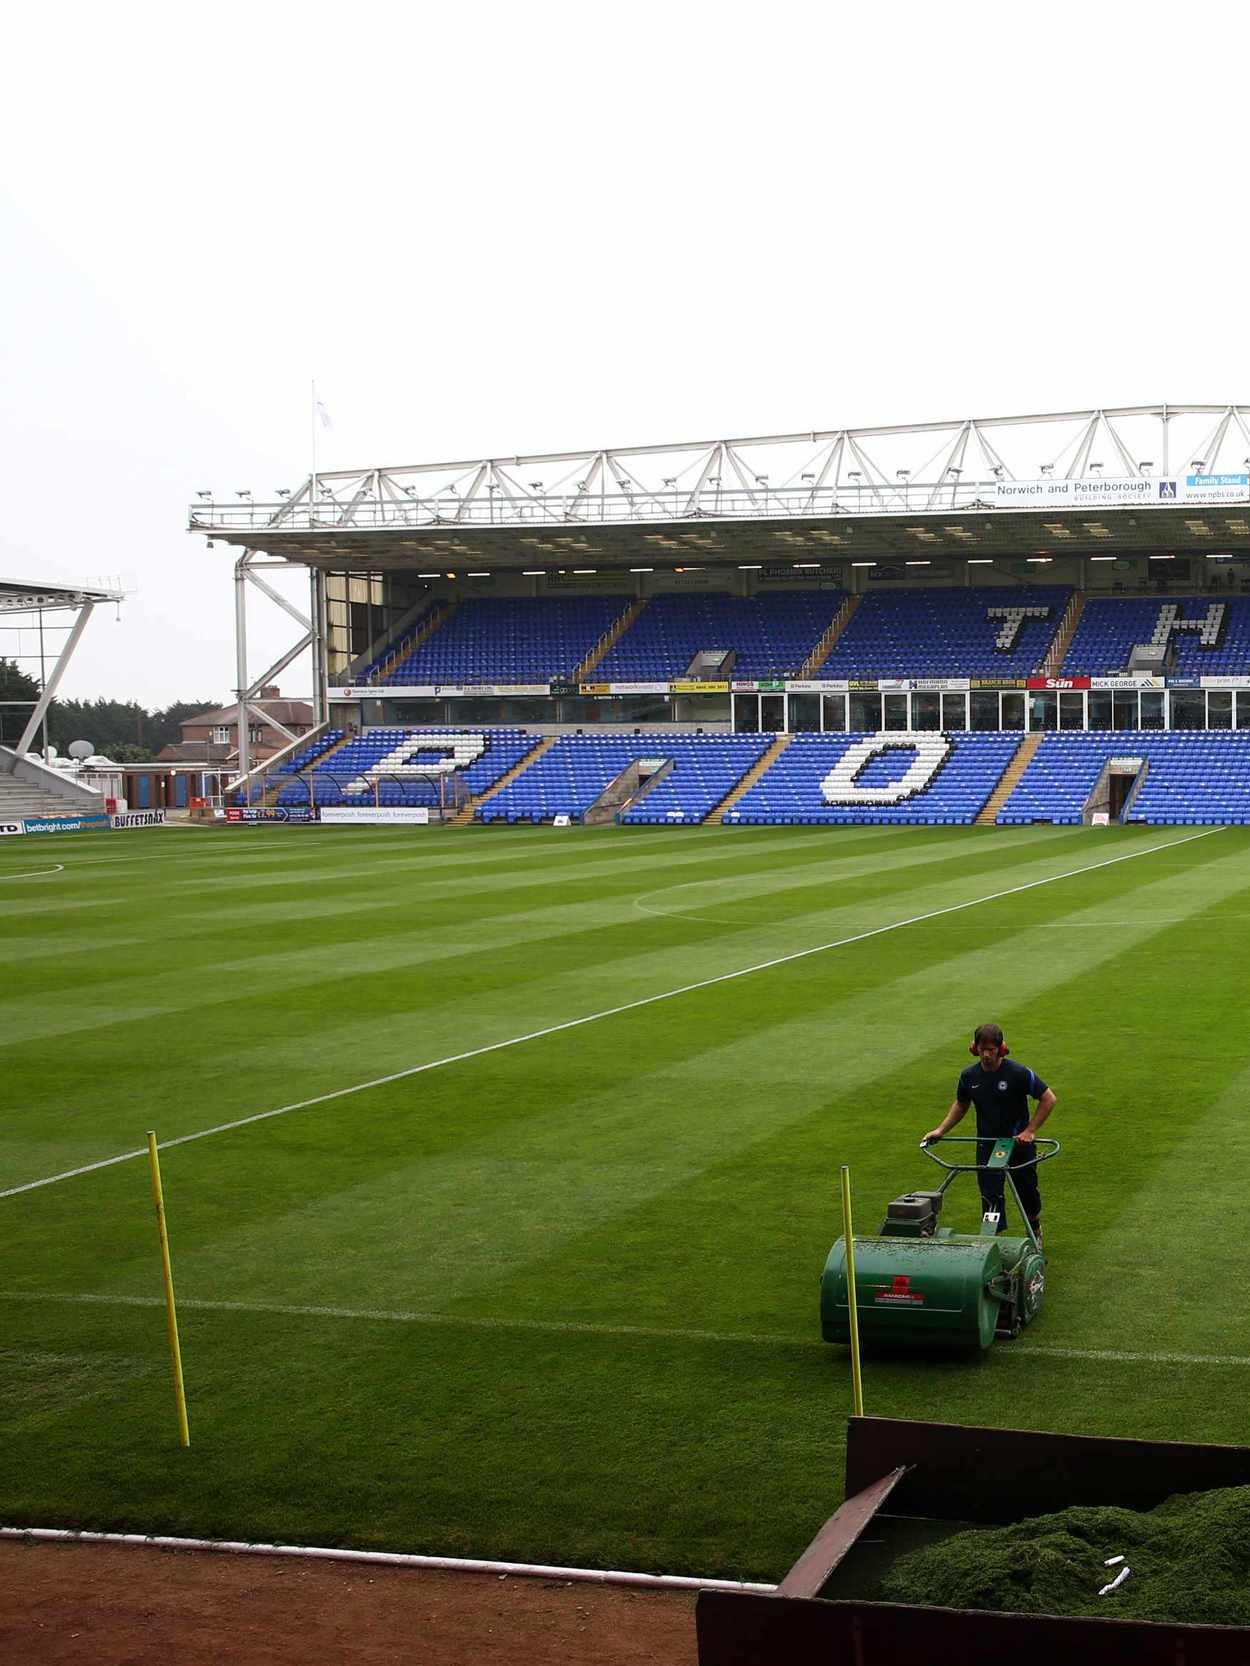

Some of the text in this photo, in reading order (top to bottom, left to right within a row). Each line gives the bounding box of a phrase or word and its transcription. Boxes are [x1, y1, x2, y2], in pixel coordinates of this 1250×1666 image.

[997, 482, 1151, 495] Norwich and Peterborough
